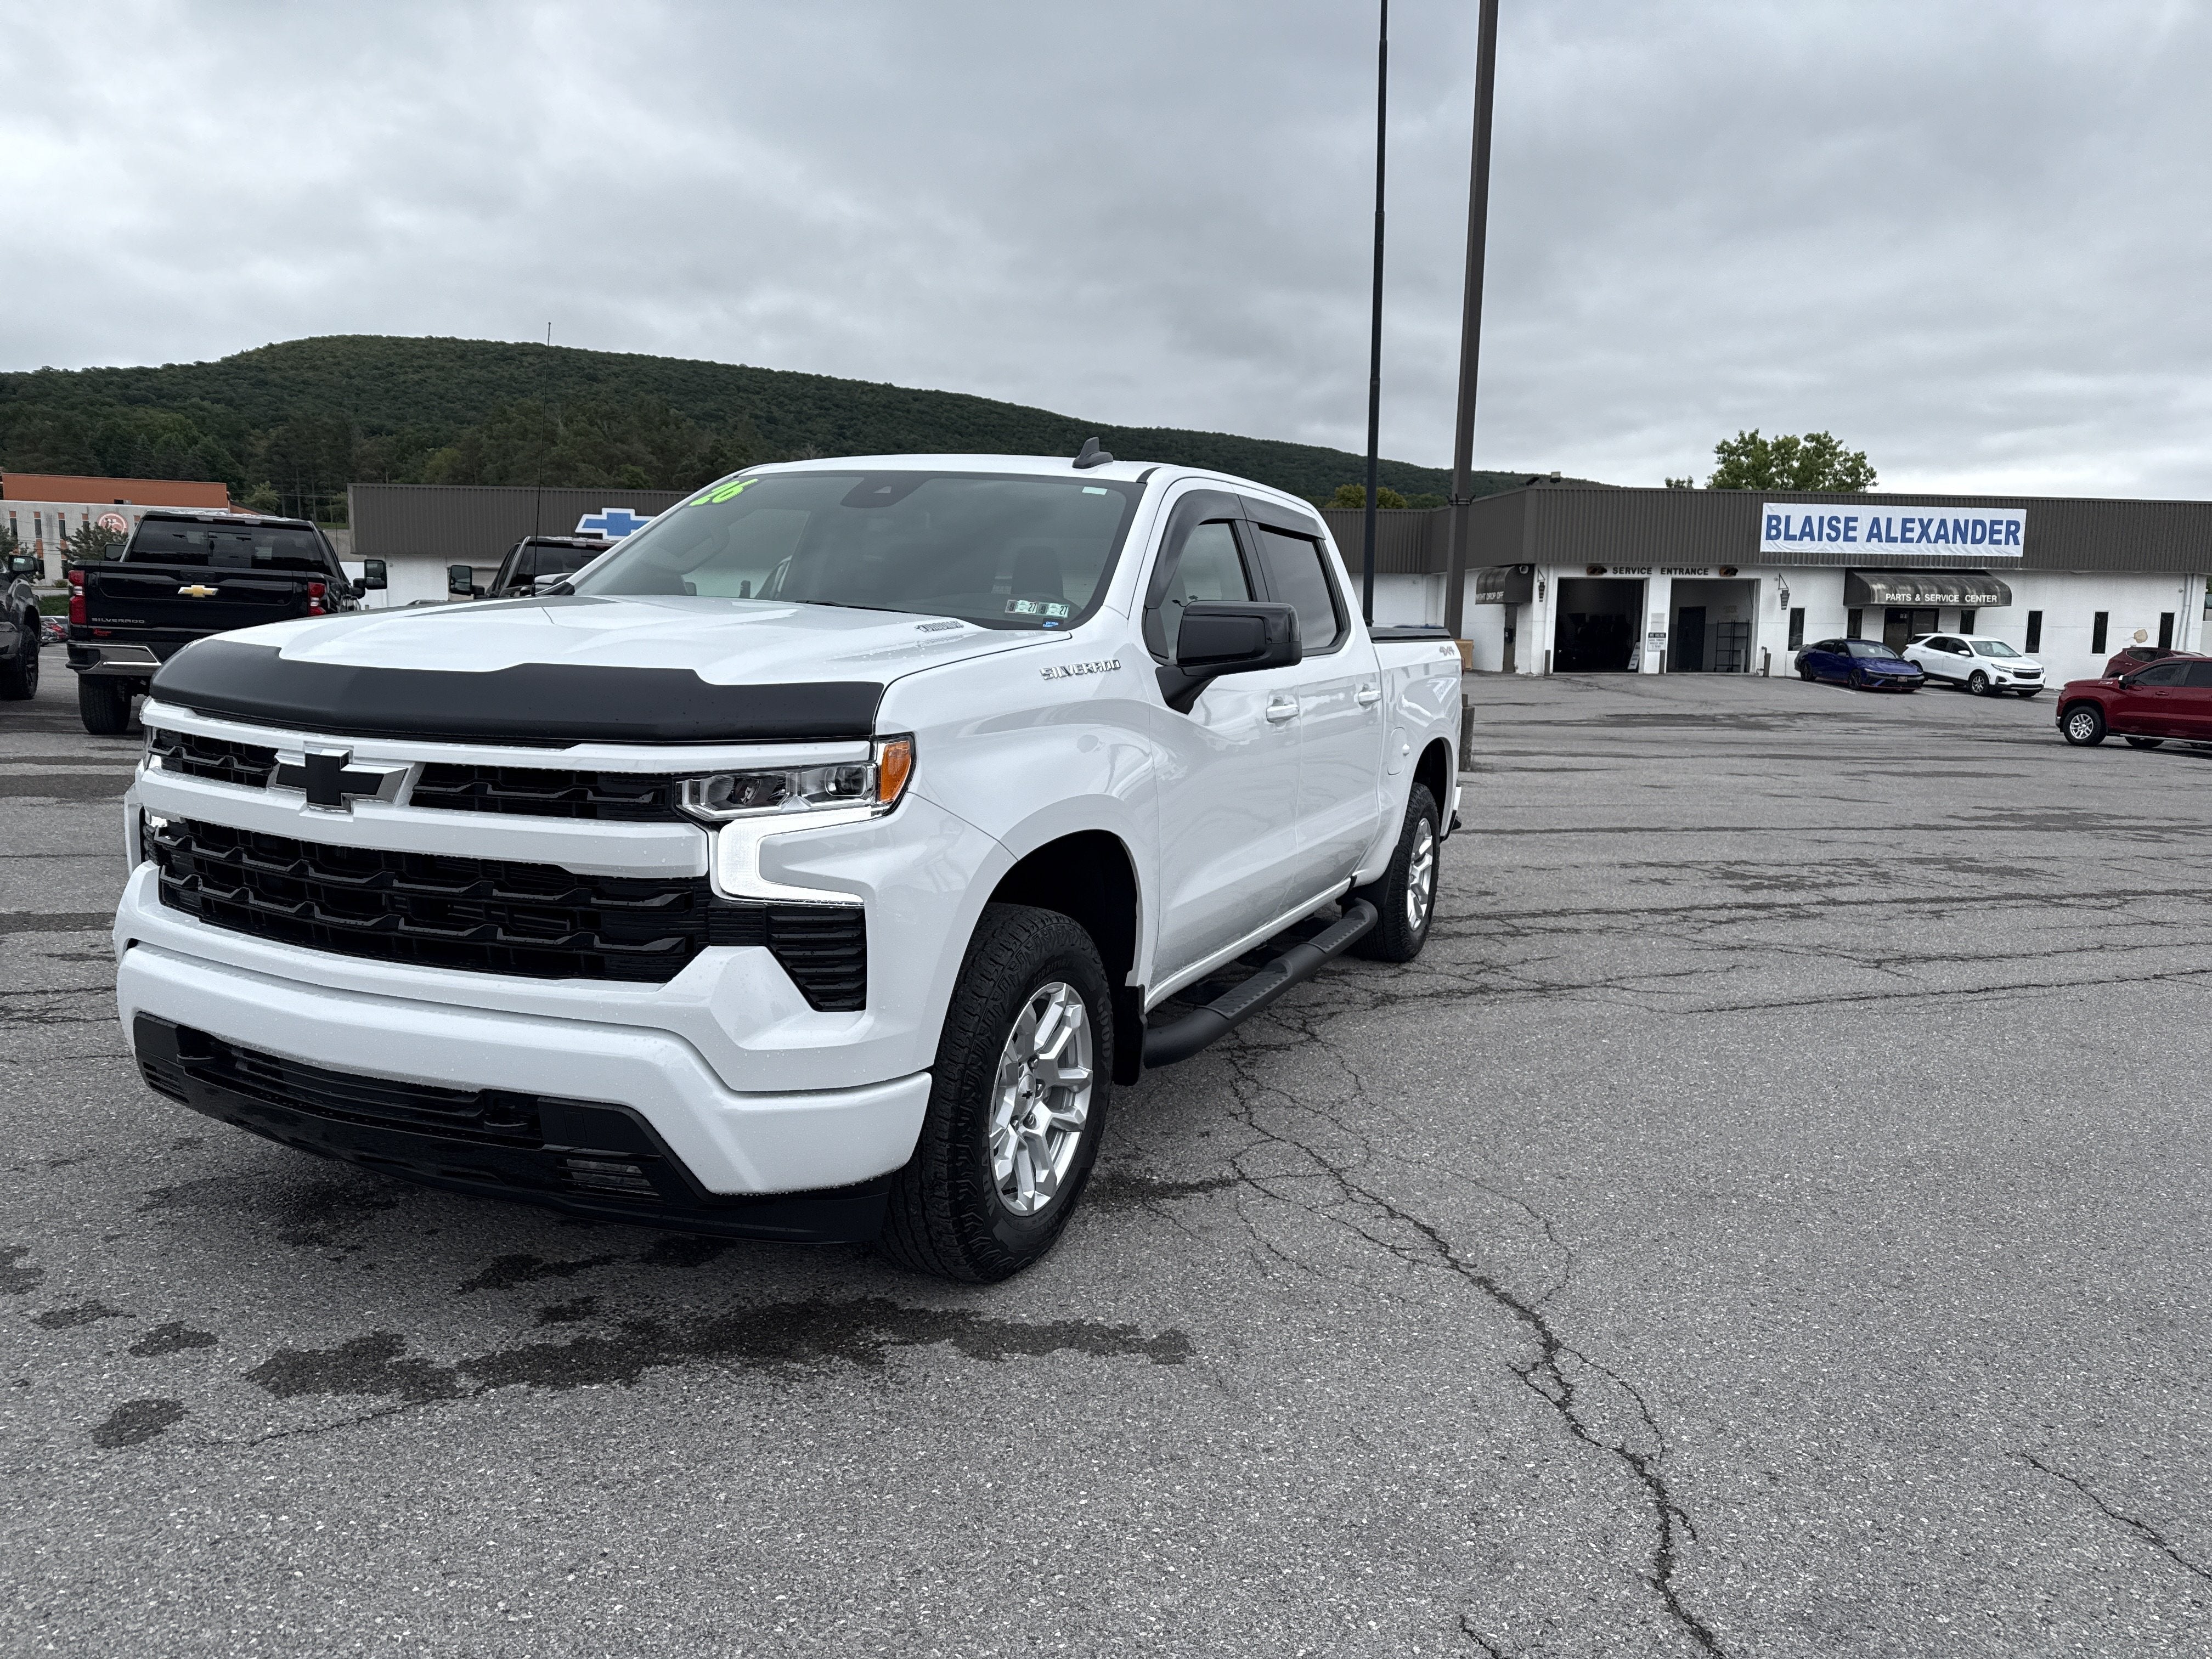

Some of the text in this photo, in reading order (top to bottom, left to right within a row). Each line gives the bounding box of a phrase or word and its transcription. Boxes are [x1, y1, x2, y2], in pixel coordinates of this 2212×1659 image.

[689, 478, 759, 506] 26
[1765, 514, 2021, 545] BLAISE ALEXANDER
[1612, 567, 1709, 575] SERVICE ENTRANCE
[1486, 592, 1496, 600] DROP
[1886, 592, 1997, 603] PARTS & SERVICE CENTER
[1009, 602, 1037, 613] 9 27
[1040, 605, 1068, 616] 9 27
[1039, 659, 1121, 680] SILVERADO
